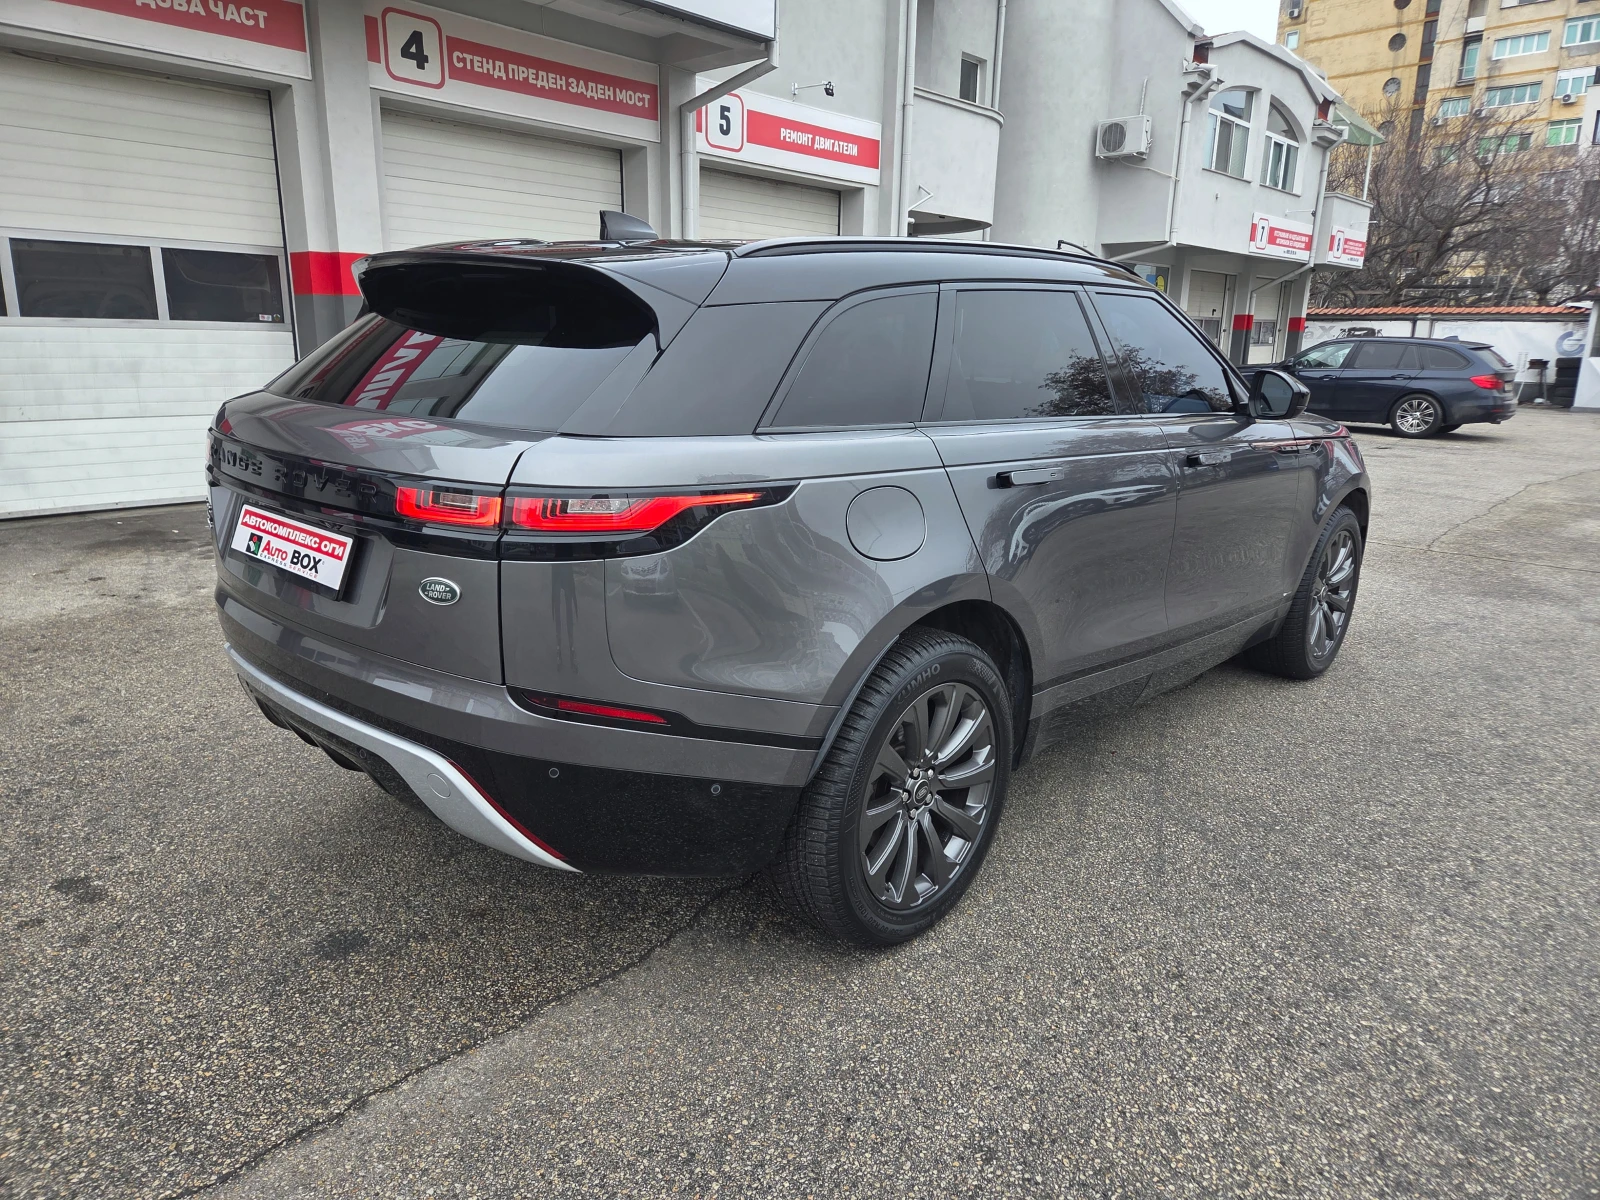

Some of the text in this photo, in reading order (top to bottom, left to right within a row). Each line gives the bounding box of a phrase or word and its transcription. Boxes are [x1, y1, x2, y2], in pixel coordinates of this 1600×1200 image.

[208, 0, 268, 29] ЧАСТ
[400, 30, 429, 71] 4
[452, 51, 651, 108] СТЕНД ПРЕДЕН ЗАДЕН МОСТ
[718, 104, 731, 136] 5
[780, 127, 858, 157] РЕМОНТ ДВИГАТЕЛИ
[1260, 225, 1266, 242] 7
[210, 443, 378, 504] RANGE ROVER
[242, 513, 345, 557] АВТОКОМПЛЕКС ОГИ
[259, 552, 318, 579] EXPRESS SERVICE
[289, 549, 322, 575] BOX
[894, 662, 941, 706] KUMHO
